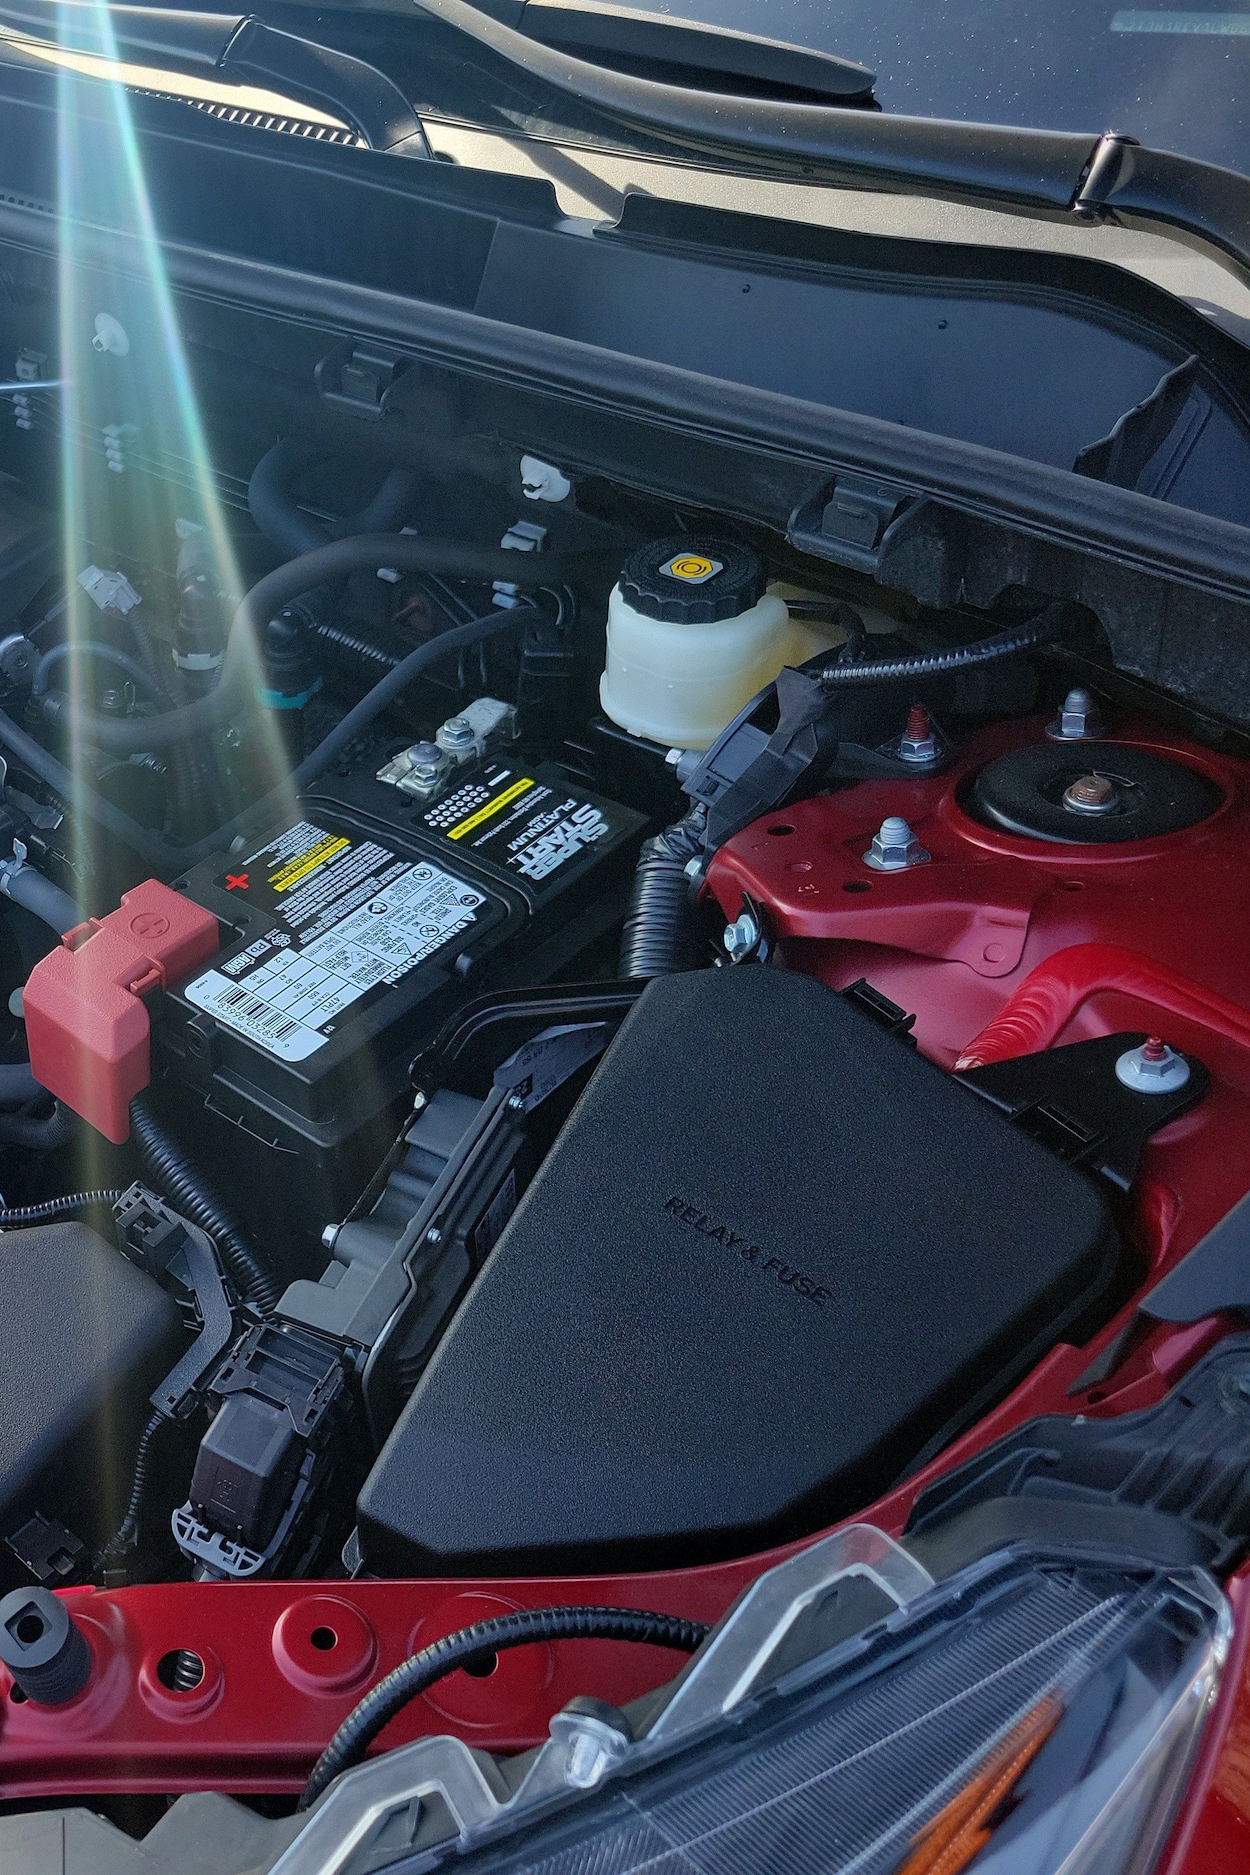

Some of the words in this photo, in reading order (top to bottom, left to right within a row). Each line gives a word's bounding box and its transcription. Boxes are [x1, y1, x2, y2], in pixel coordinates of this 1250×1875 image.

[506, 798, 577, 851] PLATINUM
[515, 802, 603, 874] START
[524, 818, 610, 882] SUPER
[248, 941, 267, 954] Pb
[332, 949, 348, 959] HELP
[381, 919, 468, 984] DANGER/POISON
[223, 953, 251, 972] AGM
[327, 954, 350, 971] MEDICAL
[353, 961, 385, 984] IMMEDIATELY
[277, 973, 288, 981] 47
[362, 974, 378, 985] EYES
[318, 995, 341, 1013] 47PLT
[217, 1002, 246, 1022] 83996
[247, 1019, 277, 1039] 03285
[322, 1025, 336, 1035] 12V
[230, 1020, 244, 1029] MADE
[246, 1030, 262, 1040] SOUTH
[259, 1038, 275, 1049] KOREA
[664, 1196, 743, 1248] RELAY
[741, 1246, 760, 1263] &
[762, 1257, 832, 1306] FUSE
